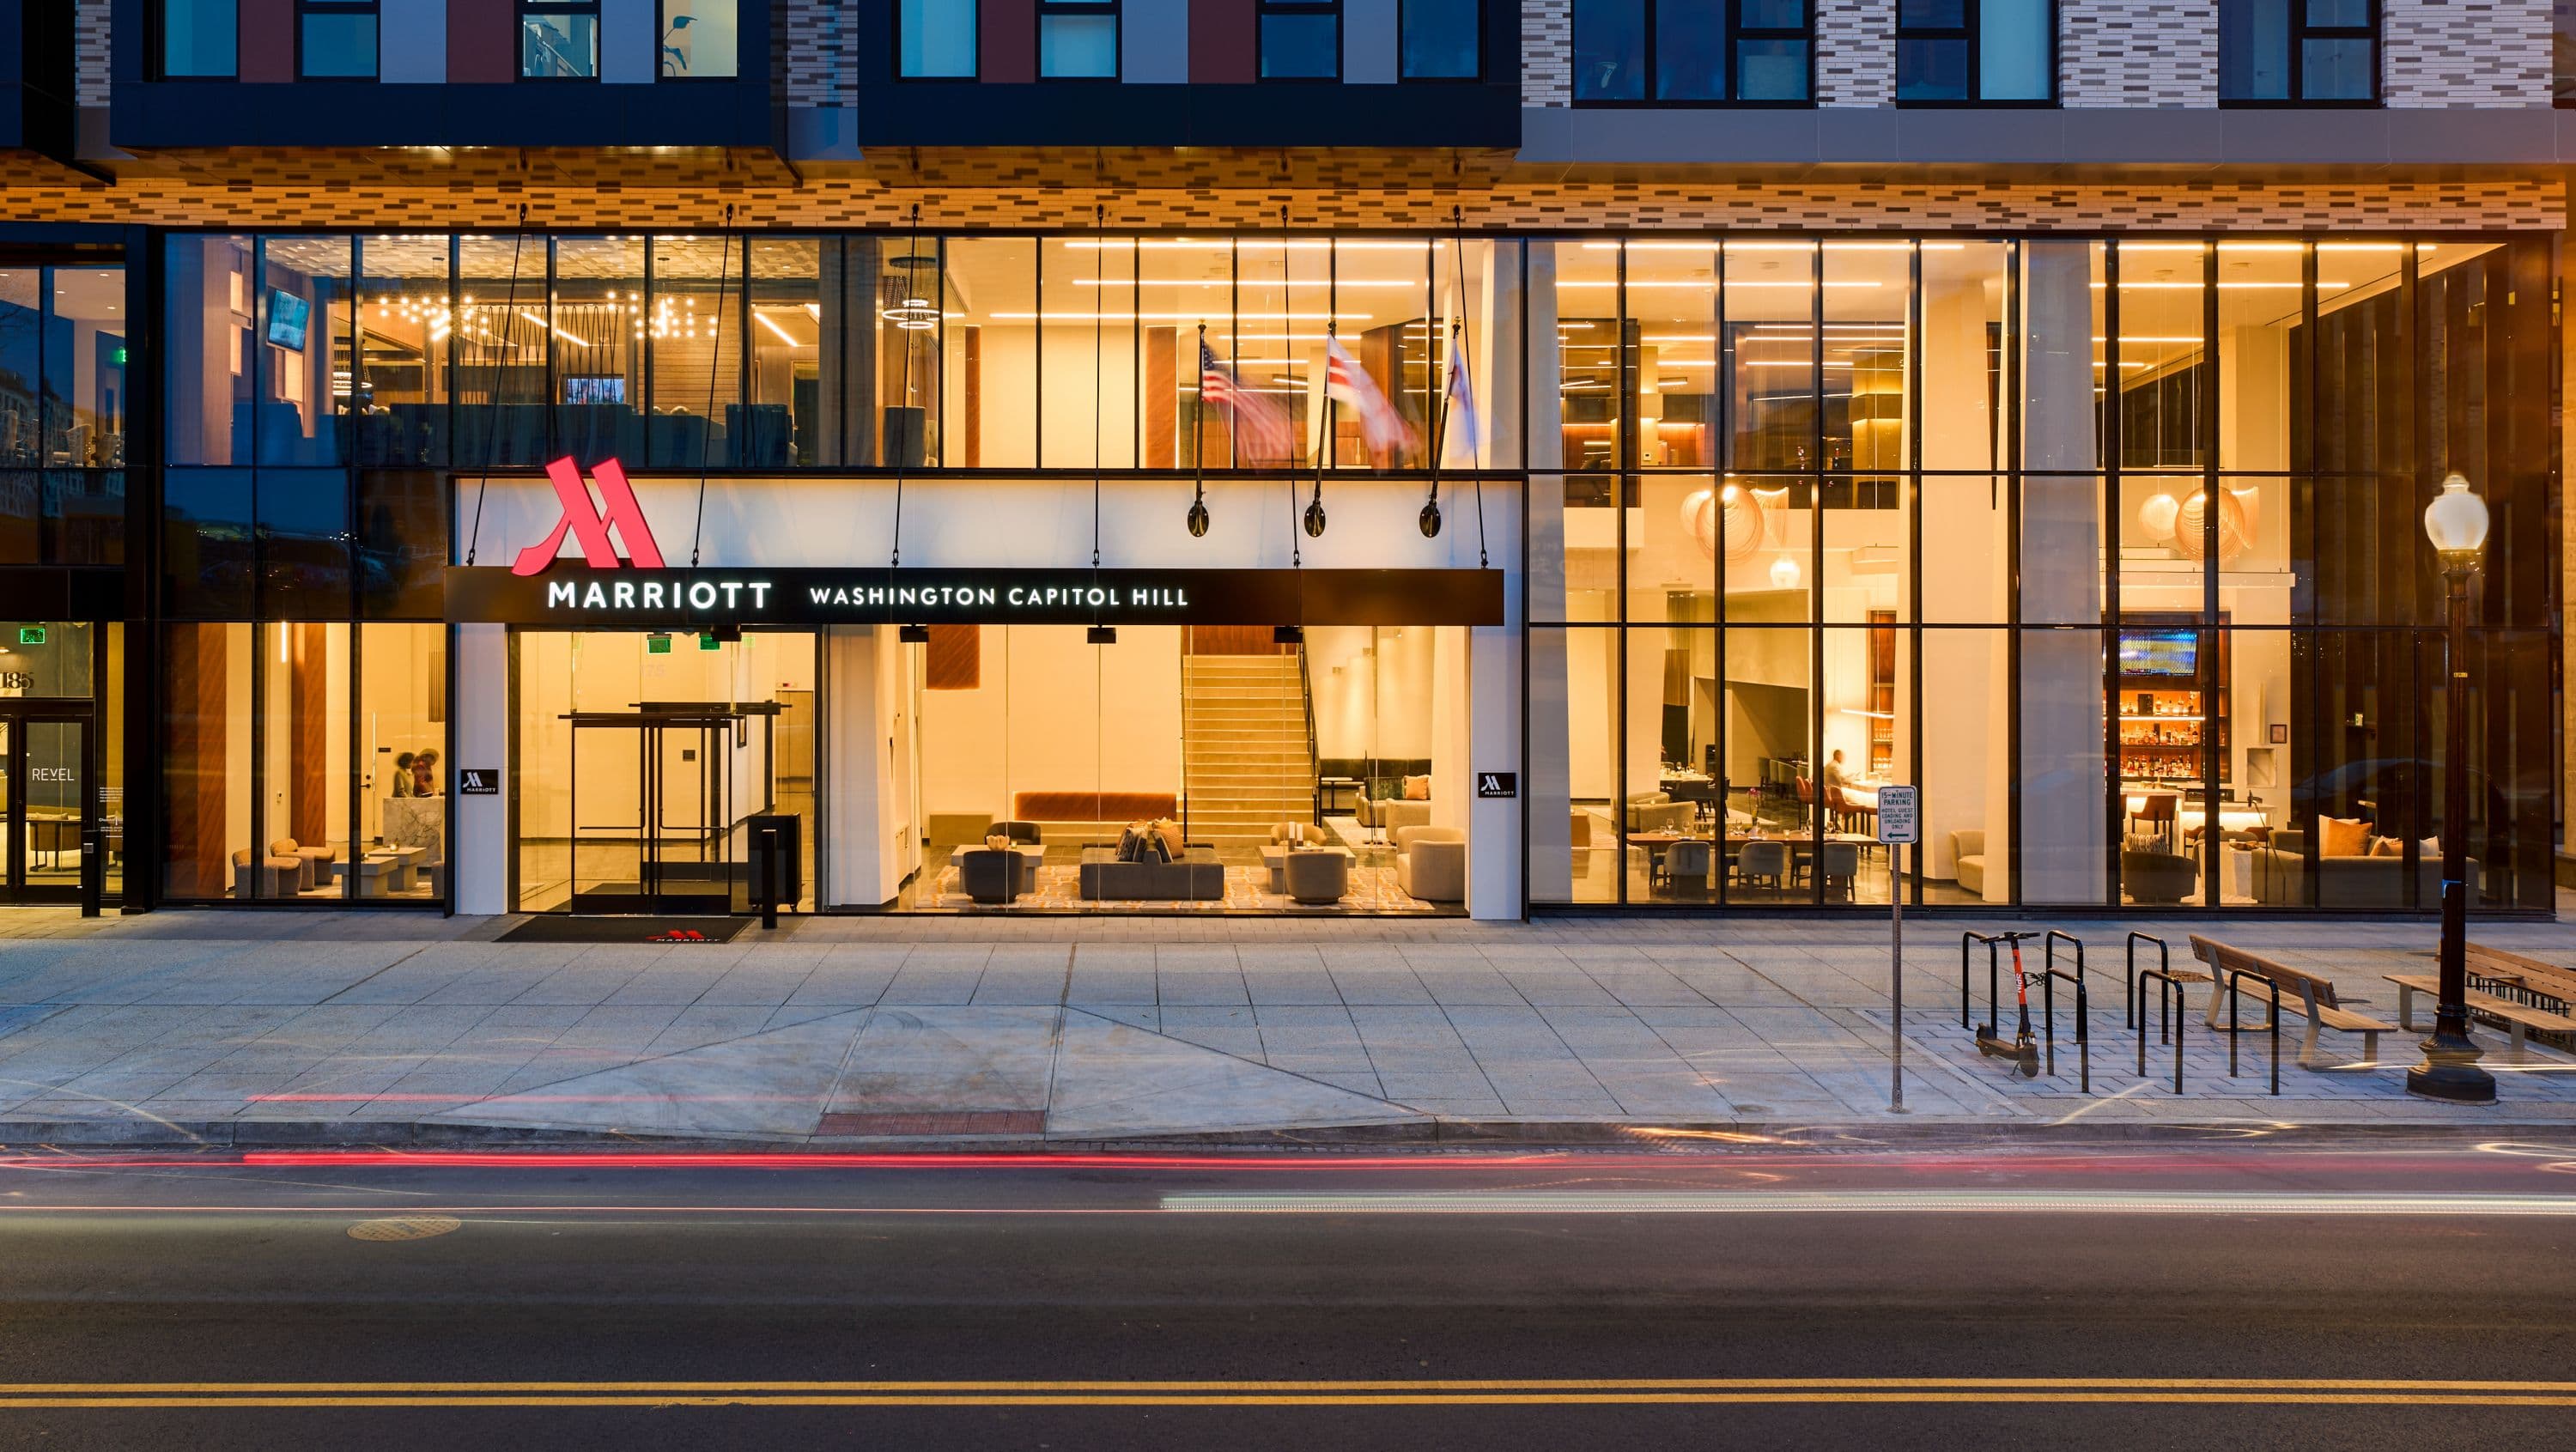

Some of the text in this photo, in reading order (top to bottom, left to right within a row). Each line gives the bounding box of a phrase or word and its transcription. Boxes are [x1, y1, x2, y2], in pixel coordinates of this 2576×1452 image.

[547, 580, 772, 610] MARRIOTT
[809, 586, 1188, 607] WASHINGTON CAPITOL HILL
[32, 768, 75, 781] REVEL
